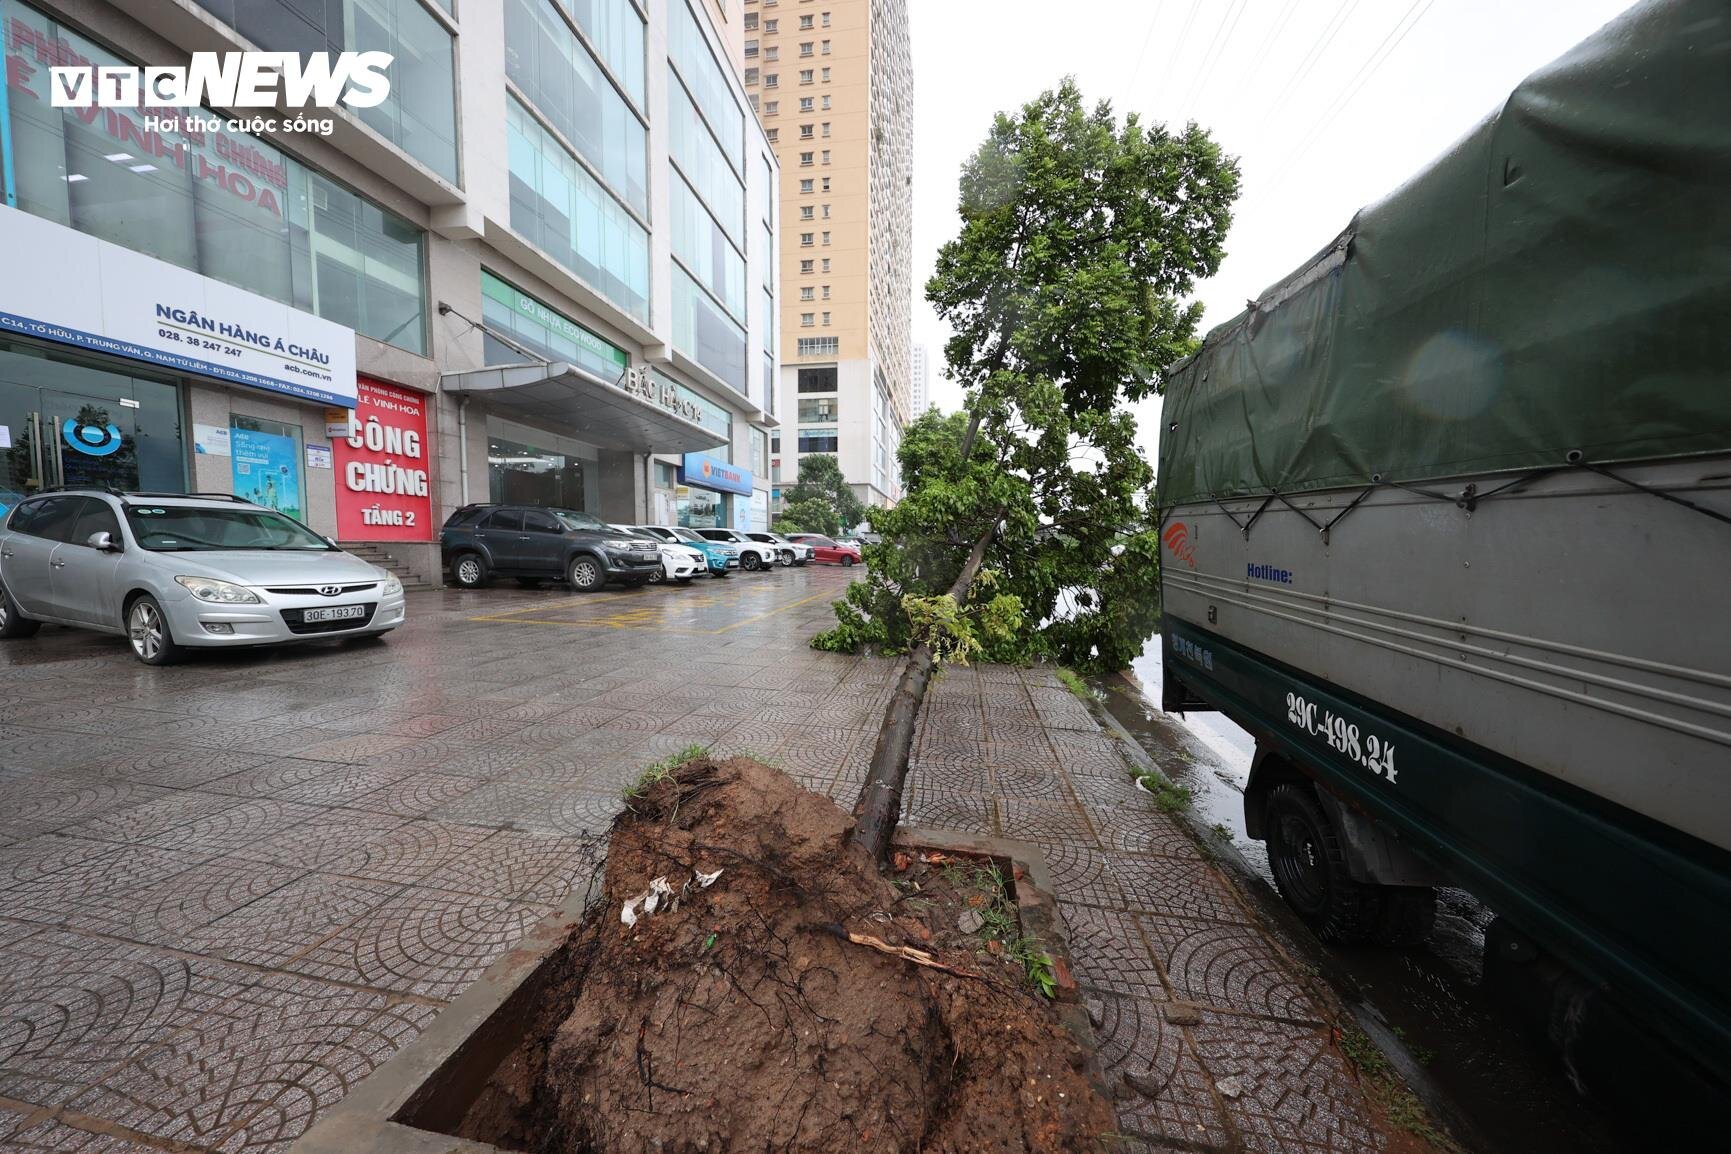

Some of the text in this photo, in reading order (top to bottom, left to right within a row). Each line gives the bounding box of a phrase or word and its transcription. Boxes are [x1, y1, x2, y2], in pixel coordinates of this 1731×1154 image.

[198, 153, 282, 218] HOA
[86, 336, 121, 351] TRUNG
[156, 303, 330, 365] NGÂN HÀNG Á CHÂU
[158, 328, 242, 358] 028. 38 247 247
[284, 363, 332, 382] acb.com.vn
[373, 397, 398, 412] VINH
[399, 405, 420, 417] HOA
[346, 415, 421, 459] CÔNG
[346, 459, 428, 497] CHỨNG
[711, 464, 742, 482] VIETBANK
[361, 503, 416, 527] TẦNG 2
[1247, 562, 1293, 584] Hotline:
[306, 606, 364, 622] 30E-19370
[1286, 692, 1398, 784] 29C-498.24
